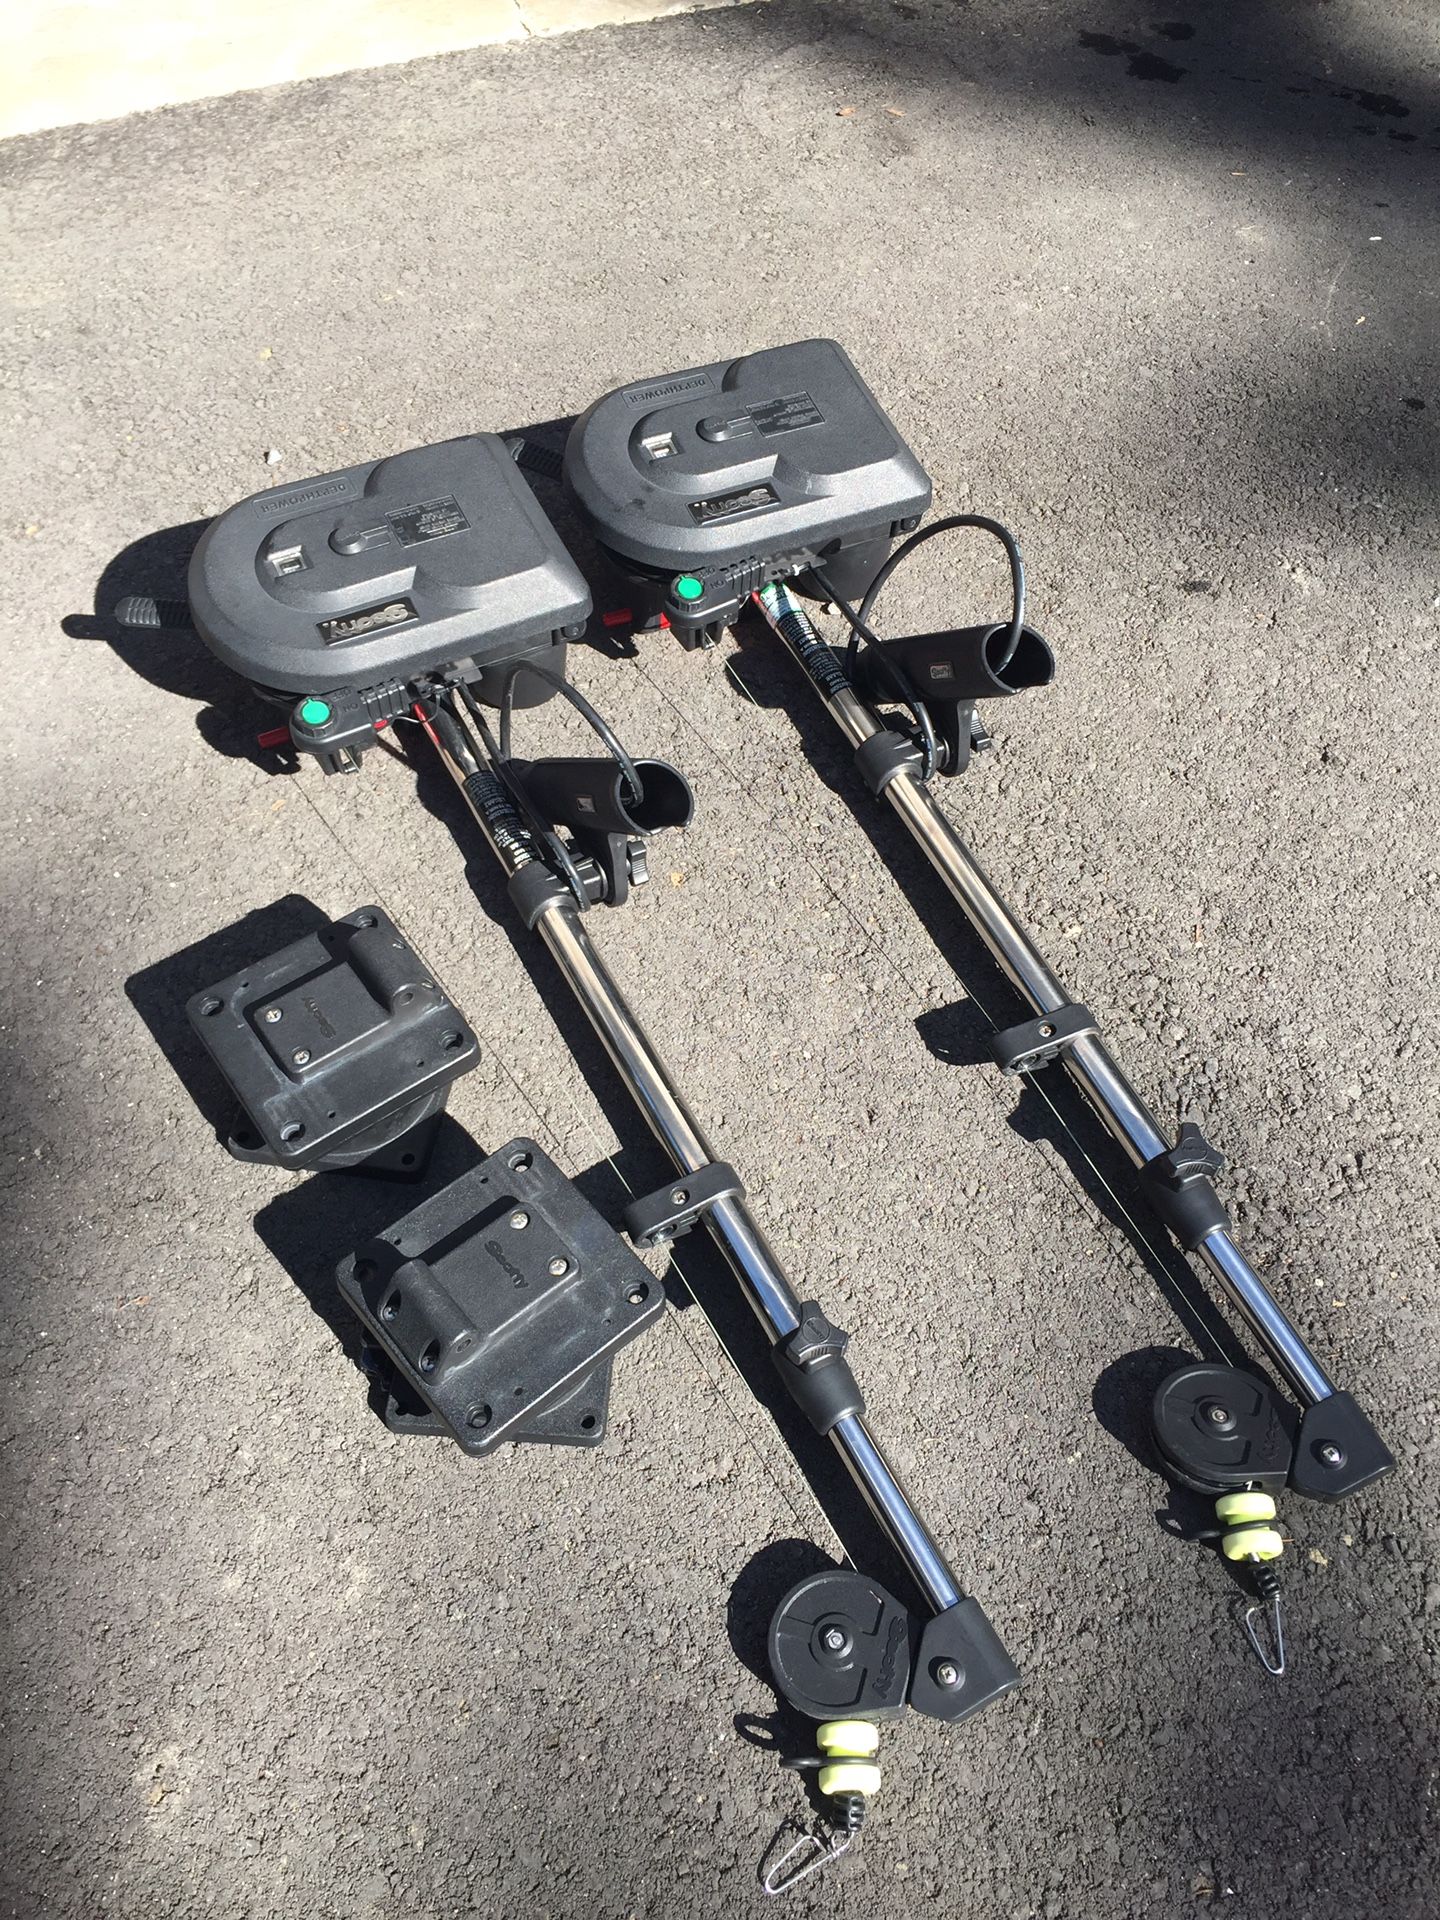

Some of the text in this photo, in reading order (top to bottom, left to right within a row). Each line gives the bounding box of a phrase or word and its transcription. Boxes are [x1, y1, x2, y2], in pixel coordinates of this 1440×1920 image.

[629, 379, 706, 403] DEPTHPOWER
[260, 483, 347, 513] DEPTHPOWER
[323, 603, 409, 639] Scotty
